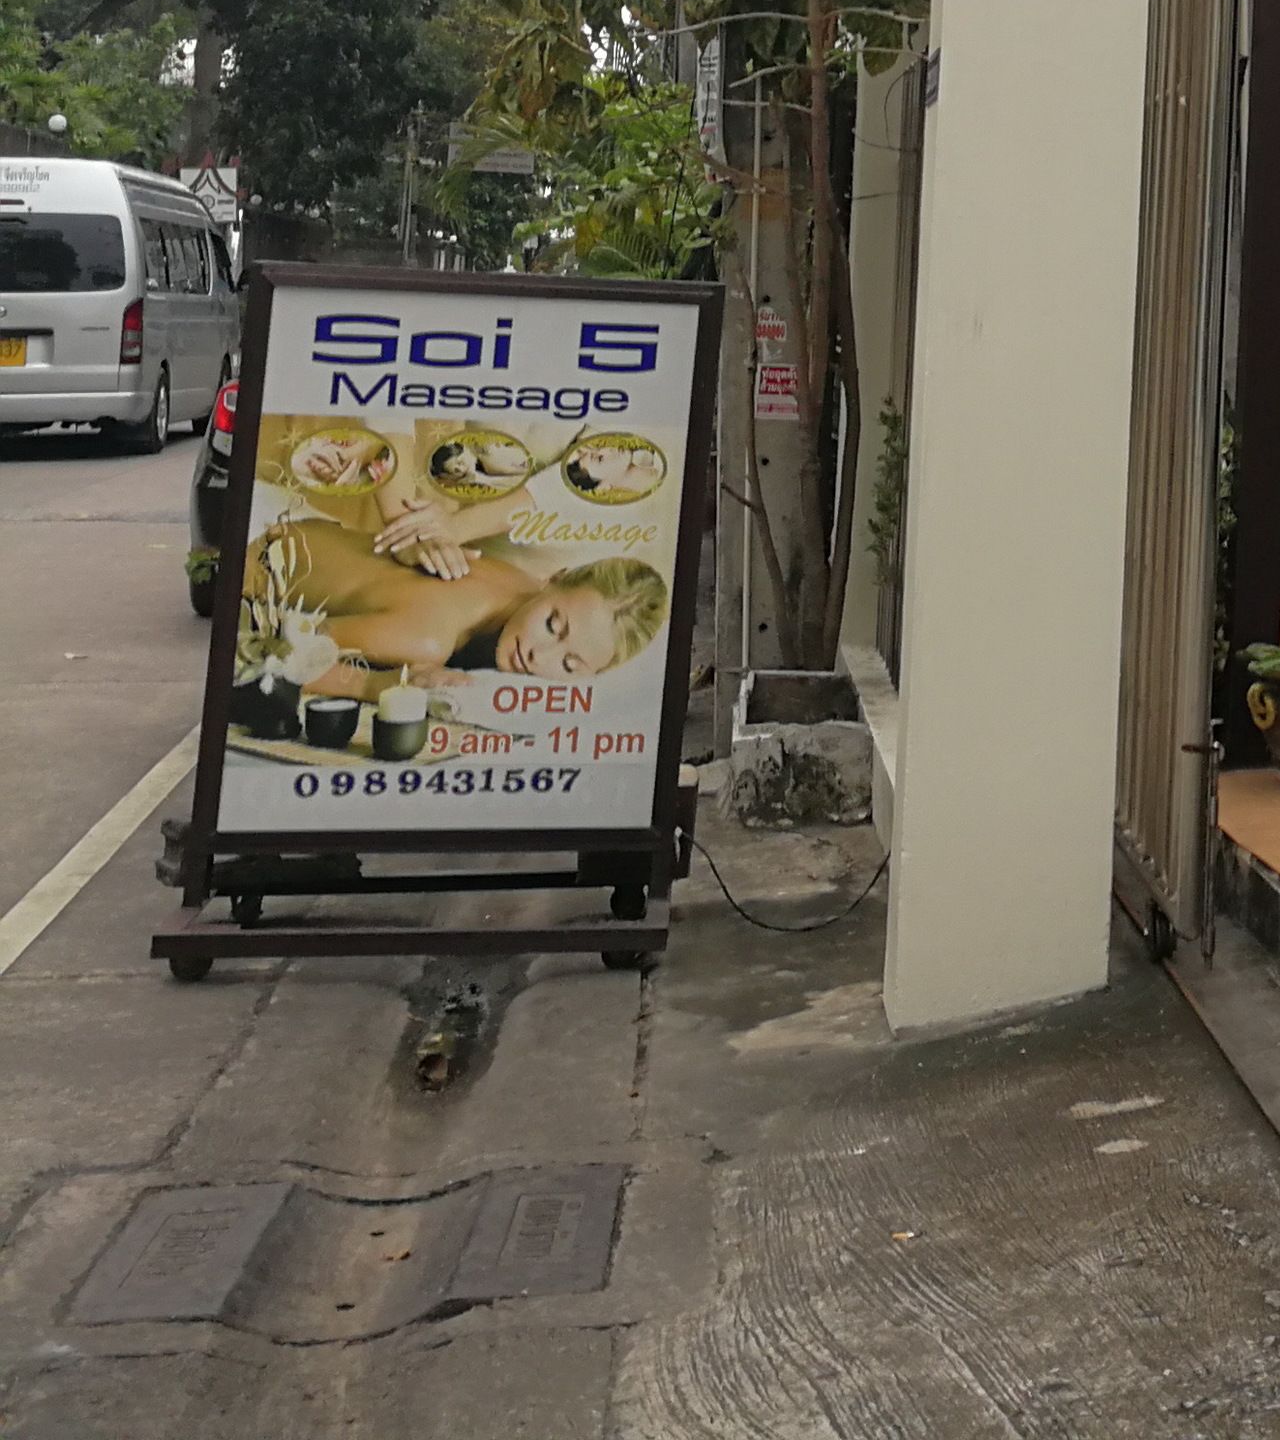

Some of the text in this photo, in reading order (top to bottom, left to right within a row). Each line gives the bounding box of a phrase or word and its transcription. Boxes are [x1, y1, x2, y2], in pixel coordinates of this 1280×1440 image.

[312, 314, 660, 374] Soi 5
[329, 372, 631, 420] Massage
[509, 509, 658, 551] Massage
[492, 685, 594, 714] OPEN
[430, 728, 448, 755] 9
[460, 732, 513, 755] am
[547, 726, 578, 755] 11
[592, 732, 647, 760] pm
